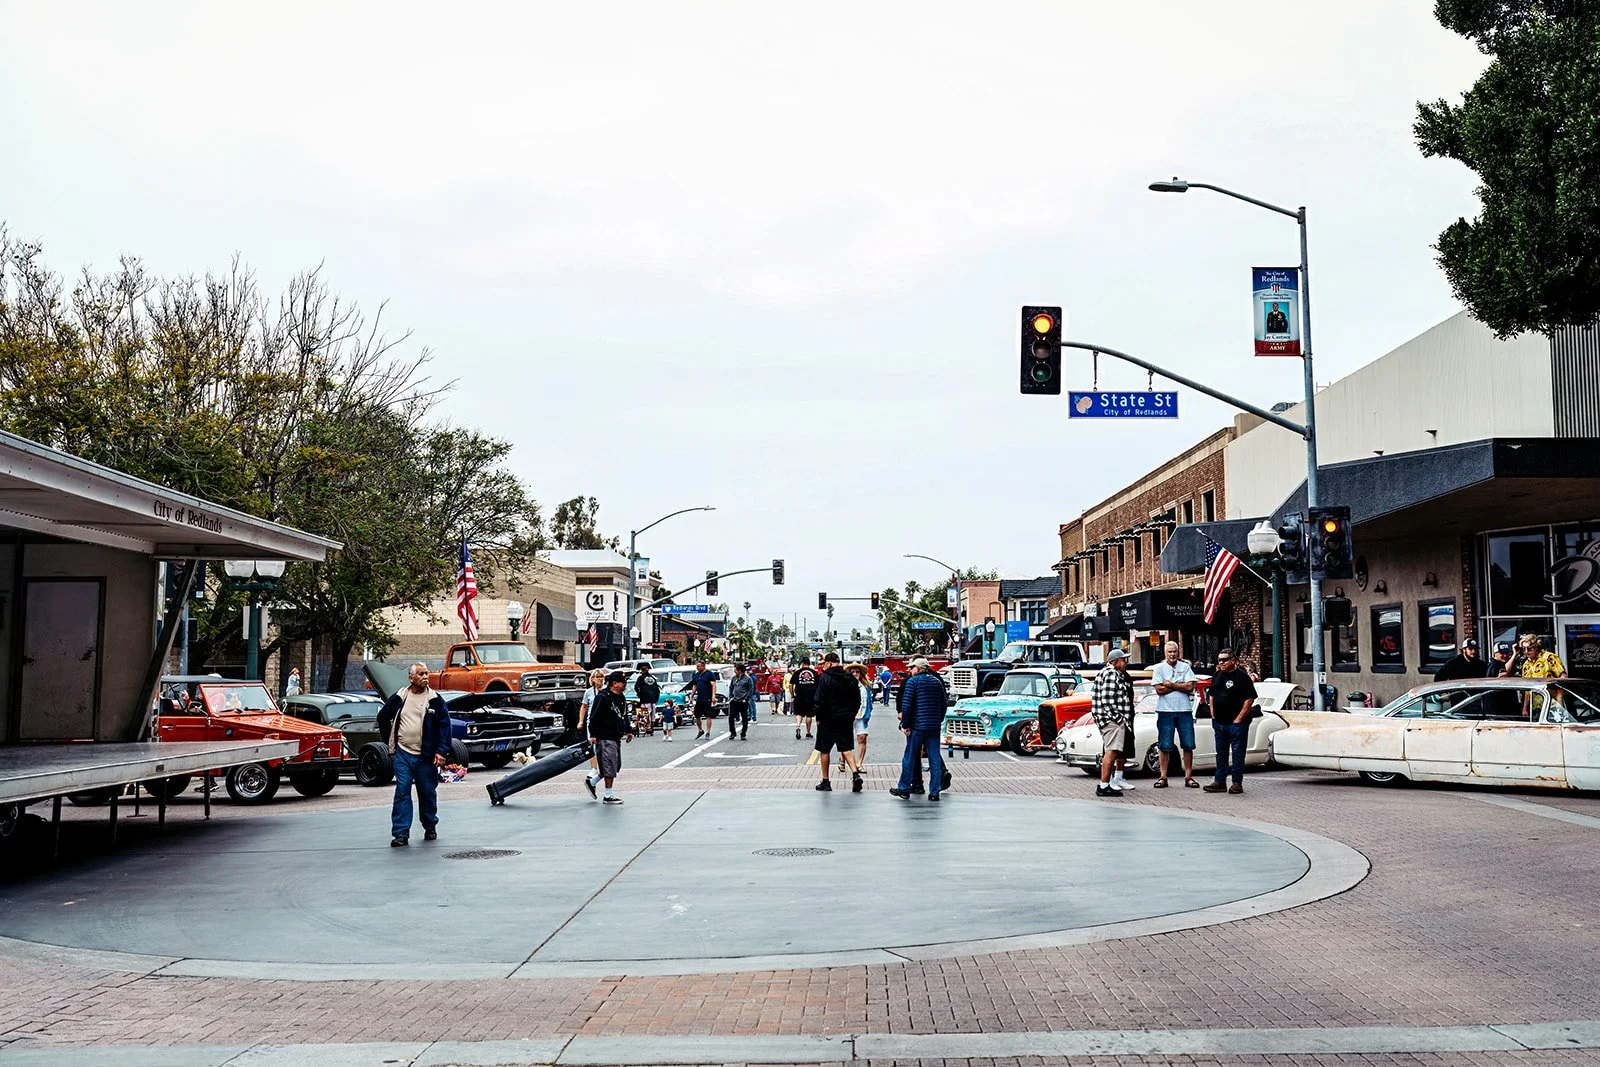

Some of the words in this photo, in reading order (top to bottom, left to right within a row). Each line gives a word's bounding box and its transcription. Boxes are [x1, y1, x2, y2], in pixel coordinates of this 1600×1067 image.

[1100, 393, 1145, 407] State
[1154, 393, 1171, 407] St
[154, 500, 173, 521] City
[175, 507, 185, 523] of
[187, 509, 223, 534] Redlands
